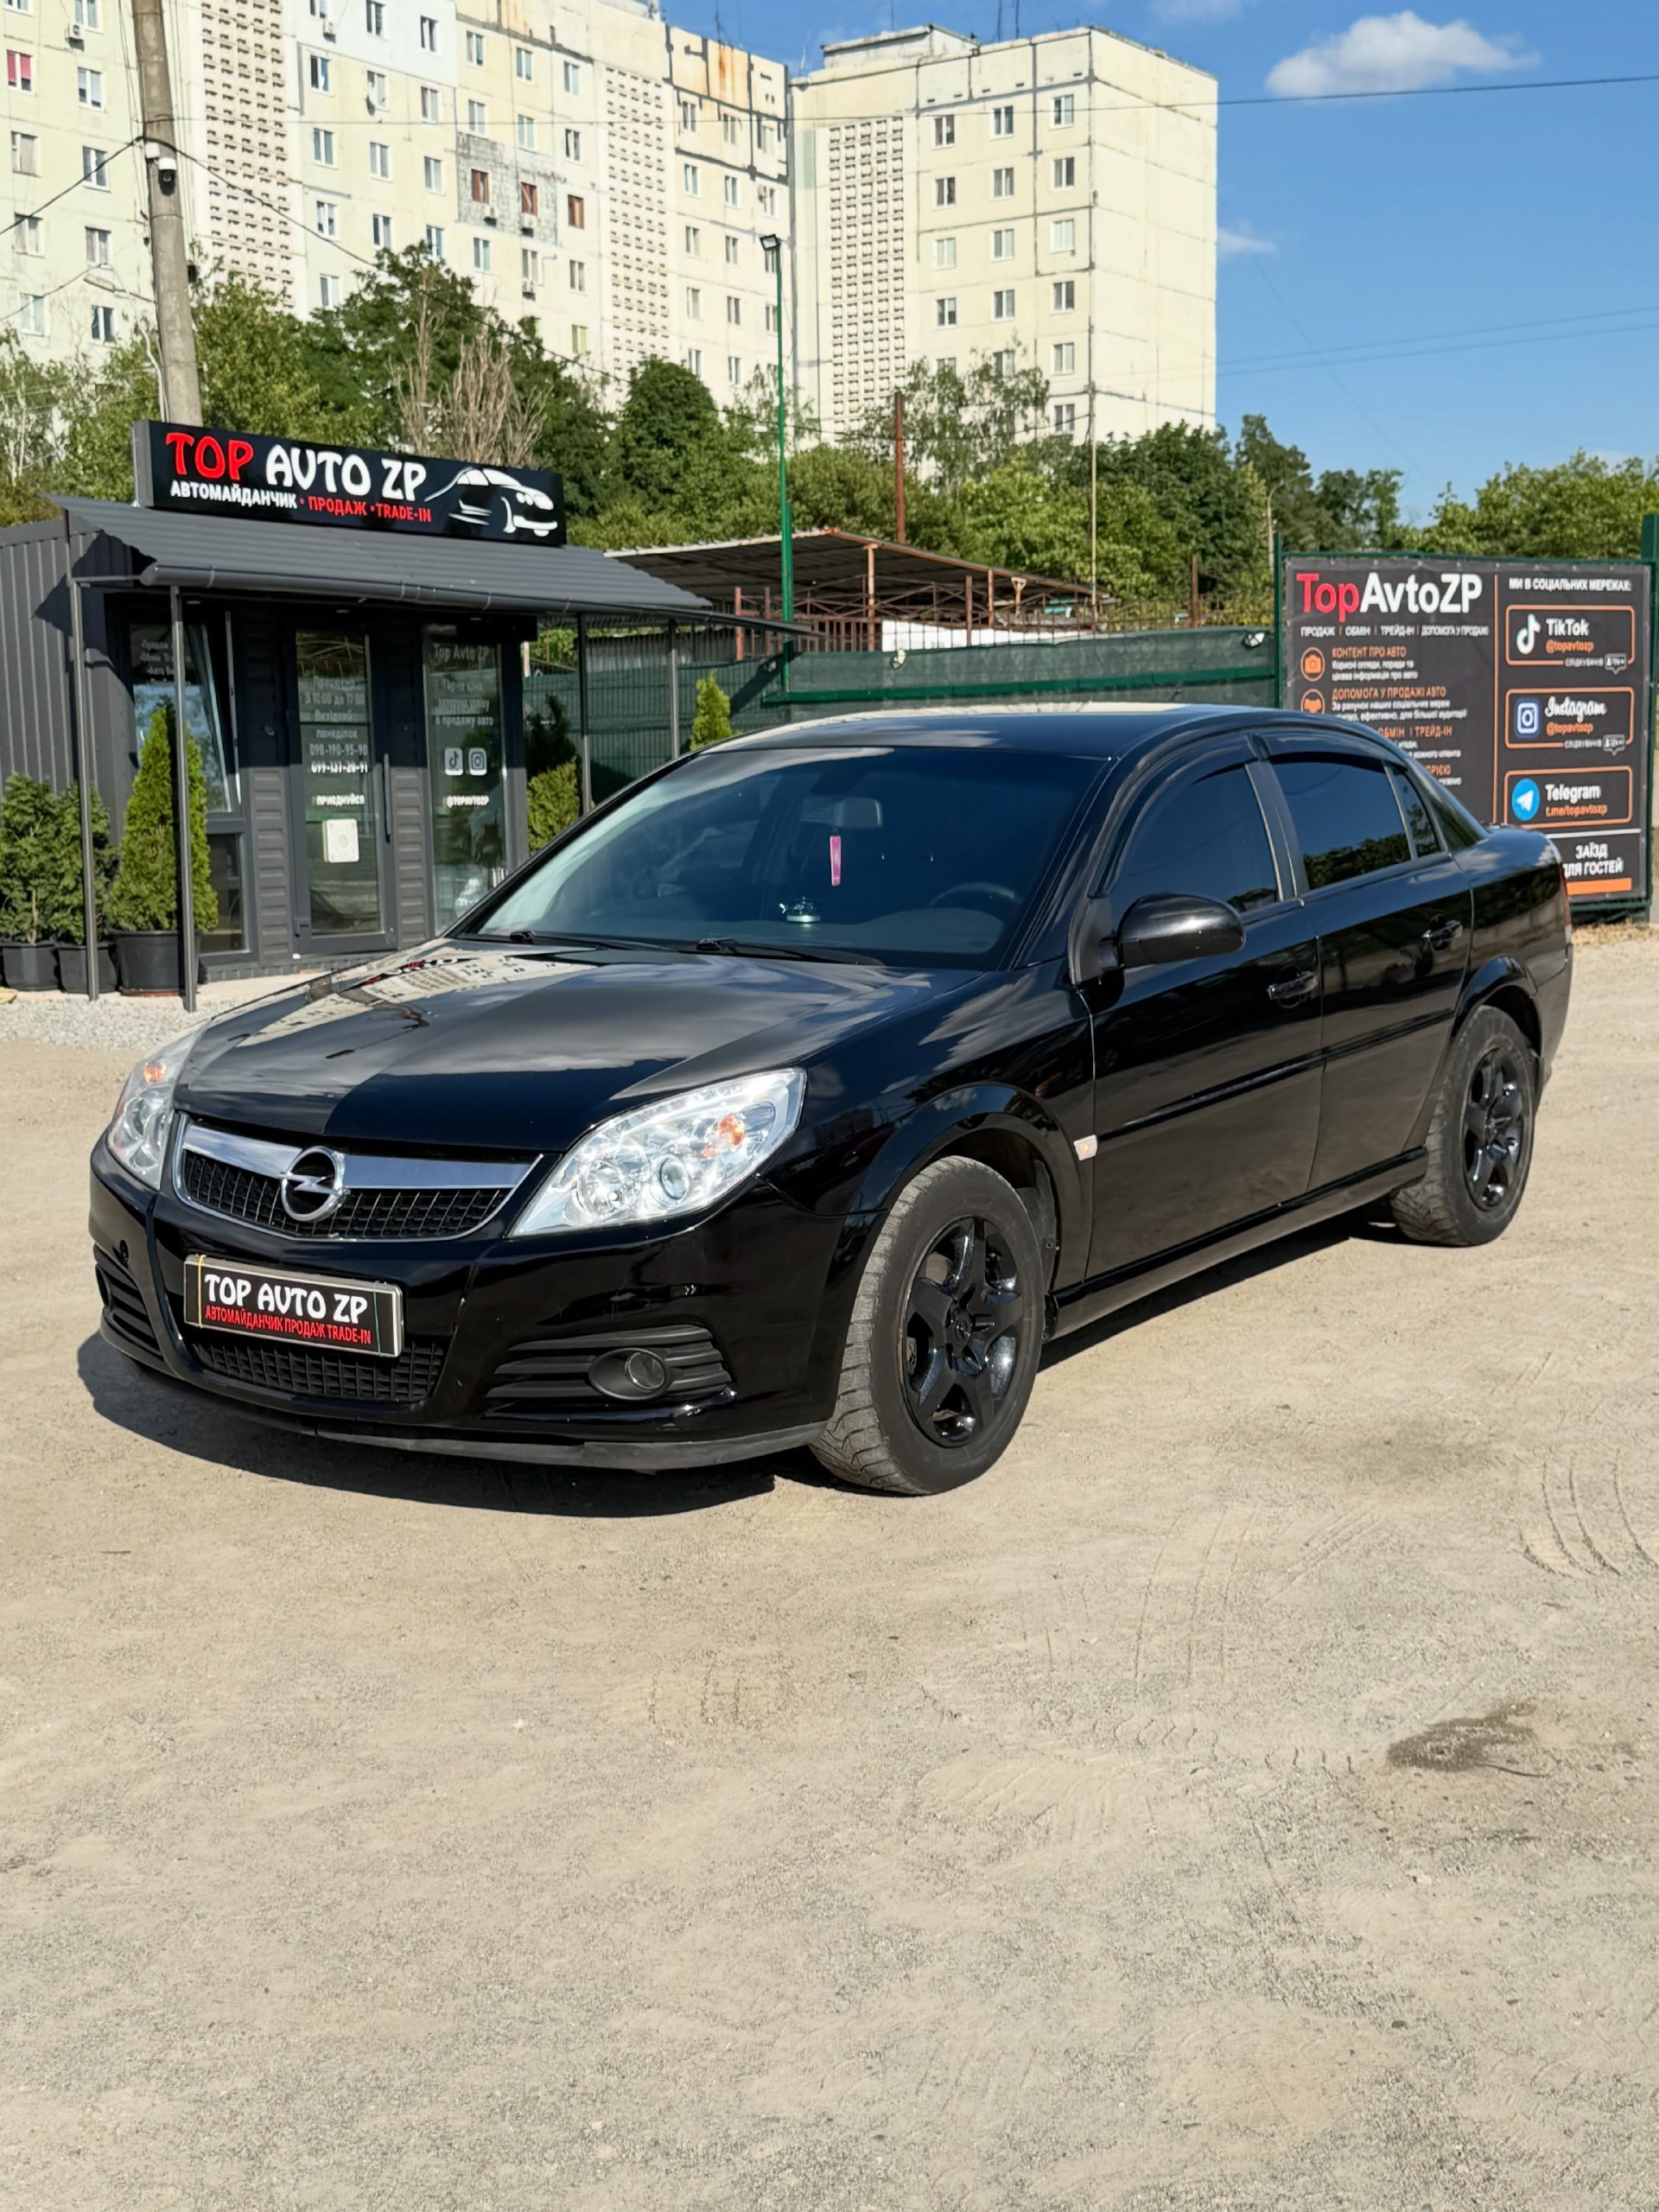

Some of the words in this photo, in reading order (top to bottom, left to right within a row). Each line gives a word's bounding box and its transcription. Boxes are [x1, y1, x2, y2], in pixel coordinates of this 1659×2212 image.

[165, 432, 254, 481] TOP
[381, 457, 427, 502] ZP
[169, 480, 298, 510] АВТОМАЙДАНЧИК
[308, 495, 367, 518] ПРОДАЖ
[375, 505, 432, 524] TRADE-IN
[1509, 577, 1522, 590] МИ
[1524, 577, 1532, 590] В
[1533, 578, 1588, 592] СОЦІАЛЬНИХ
[1296, 571, 1483, 622] TopAvtoZP
[1300, 626, 1336, 638] ПРОДАЖ
[1545, 618, 1590, 637] TikTok
[1332, 646, 1367, 658] КОНТЕНТ
[1369, 646, 1385, 658] ПРО
[1386, 646, 1407, 658] АВТО
[1332, 688, 1378, 701] ДОПОМОГА
[1380, 688, 1386, 699] У
[1387, 687, 1426, 699] ПРОДАЖІ
[1427, 686, 1447, 698] АВТО
[1545, 696, 1607, 723] Instagram
[1414, 725, 1452, 738] ТРЕЙД-ІН
[1545, 784, 1601, 804] Telegram
[1575, 842, 1608, 860] ЗАЇЗД
[1584, 856, 1624, 875] ГОСТЕЙ
[204, 1274, 251, 1306] TOP
[333, 1294, 367, 1324] ZP
[204, 1305, 283, 1332] АВТОМАЙДАНЧИК
[283, 1319, 327, 1338] ПРОДАЖ
[327, 1325, 372, 1344] TRADE-IN
